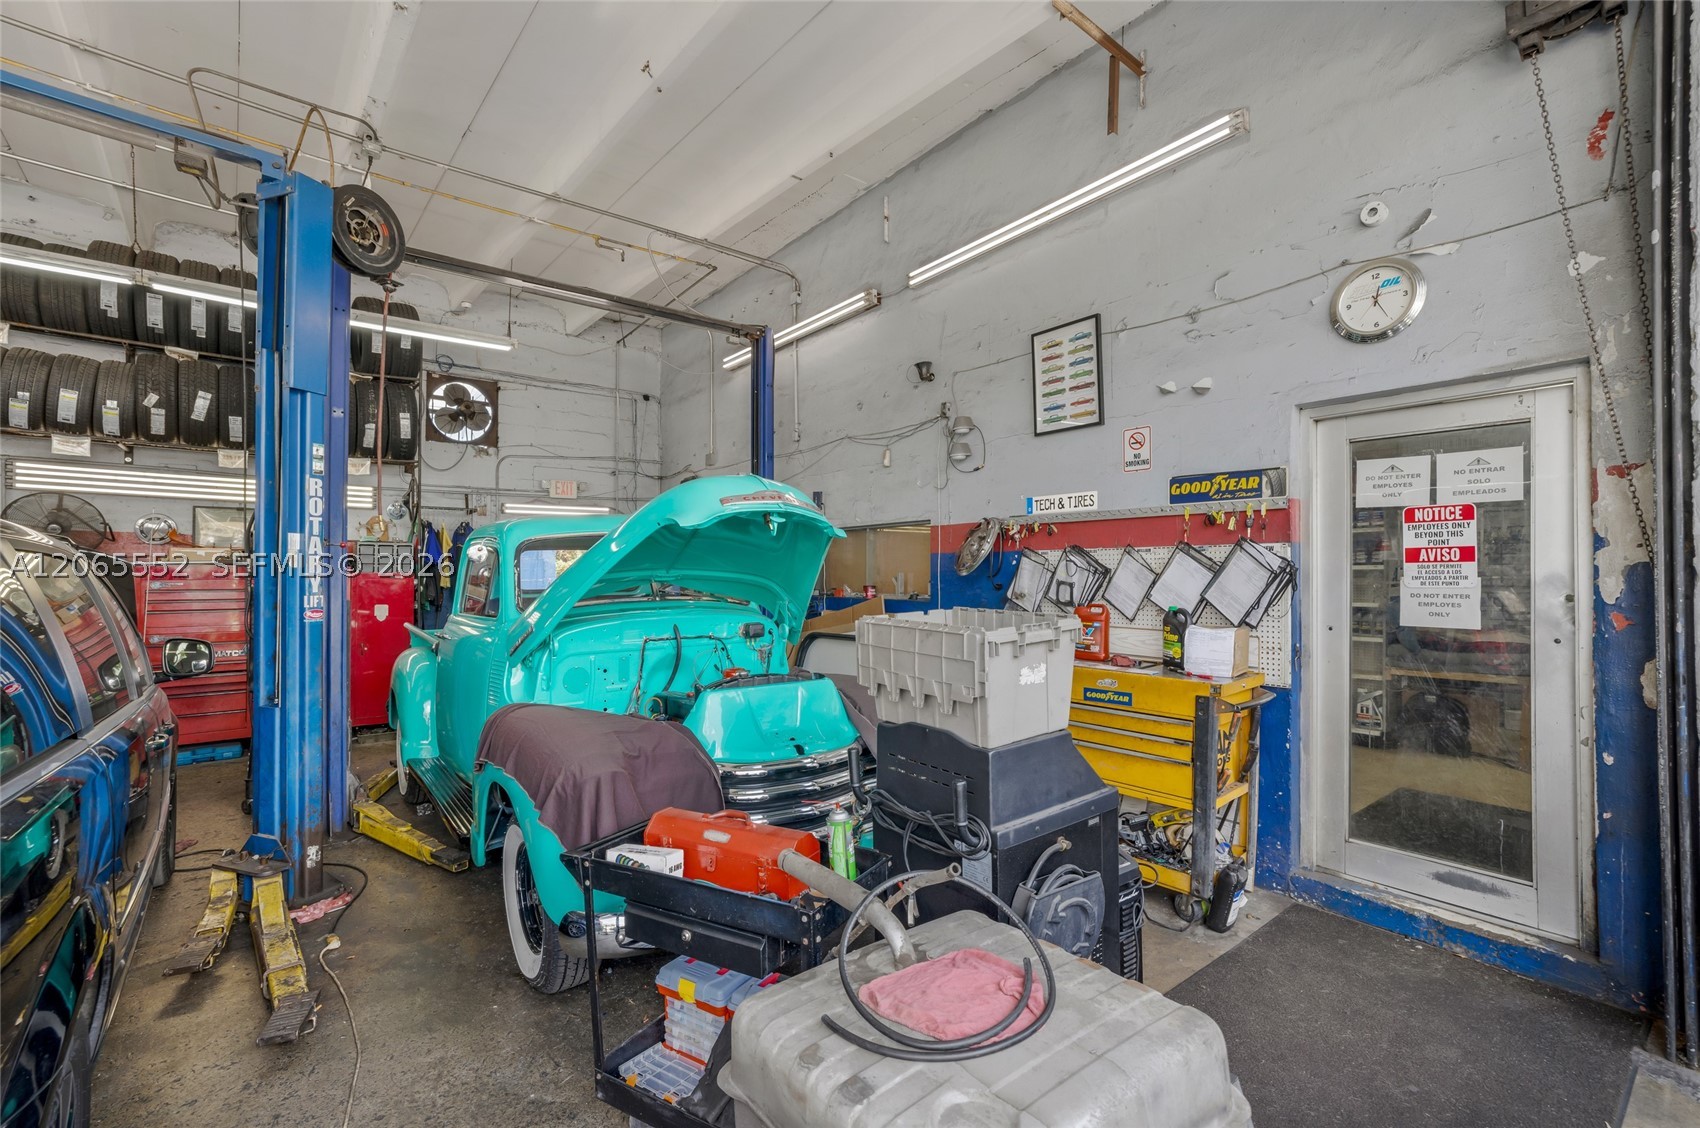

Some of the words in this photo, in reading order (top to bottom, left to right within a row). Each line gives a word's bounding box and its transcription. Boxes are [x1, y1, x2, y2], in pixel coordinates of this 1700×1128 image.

[1380, 276, 1401, 288] OIL
[1125, 459, 1149, 468] SMOKING
[1468, 466, 1505, 474] ENTRAR
[555, 480, 574, 496] EXIT
[1171, 475, 1260, 496] GOODYEAR
[1452, 488, 1507, 496] EMPLEADOS
[1034, 498, 1056, 511] TECH
[1057, 497, 1065, 509] &
[1067, 494, 1095, 508] TIRES
[1414, 506, 1463, 521] NOTICE
[1407, 523, 1449, 531] EMPLOYEES
[1414, 531, 1444, 539] BEYOND
[1419, 547, 1460, 562] AVISO
[1086, 691, 1130, 703] GOODYEAR
